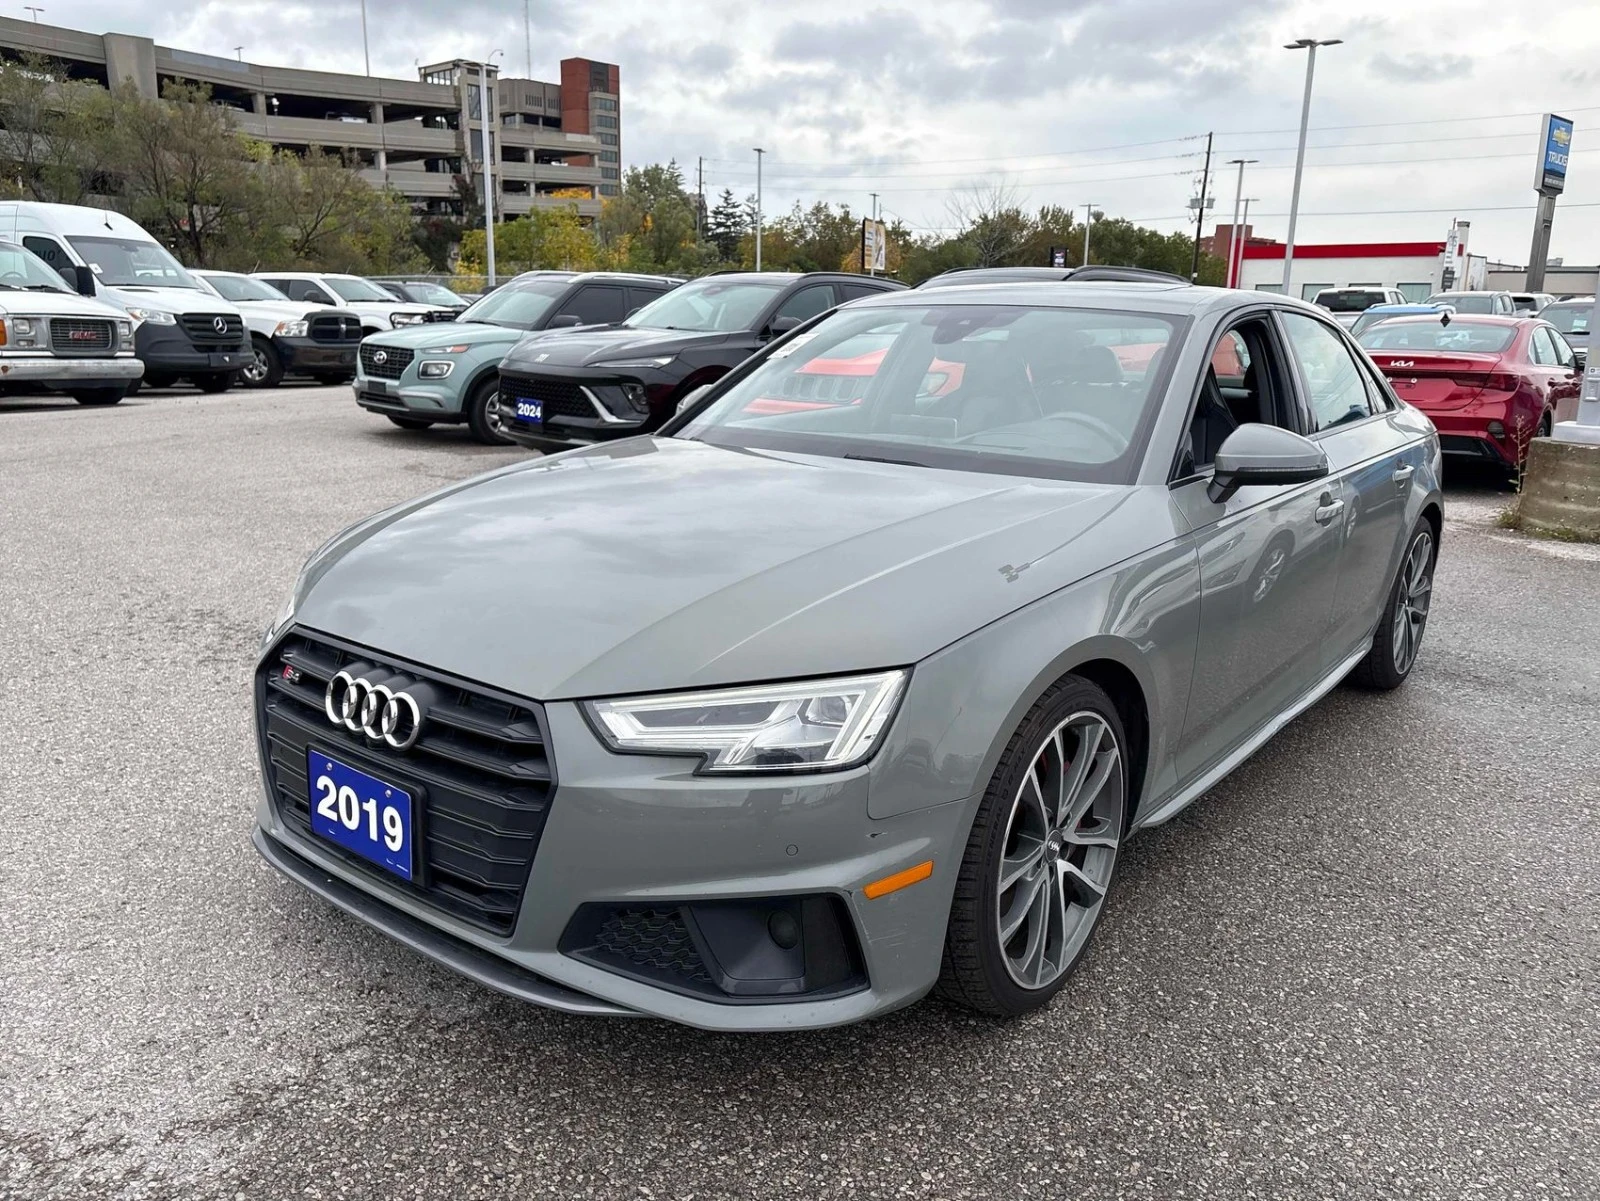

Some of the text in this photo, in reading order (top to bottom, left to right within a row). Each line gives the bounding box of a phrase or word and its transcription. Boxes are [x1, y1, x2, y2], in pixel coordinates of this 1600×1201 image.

[69, 330, 97, 340] GMC
[1390, 360, 1415, 368] KIA
[517, 402, 541, 419] 2024
[316, 775, 404, 852] 2019
